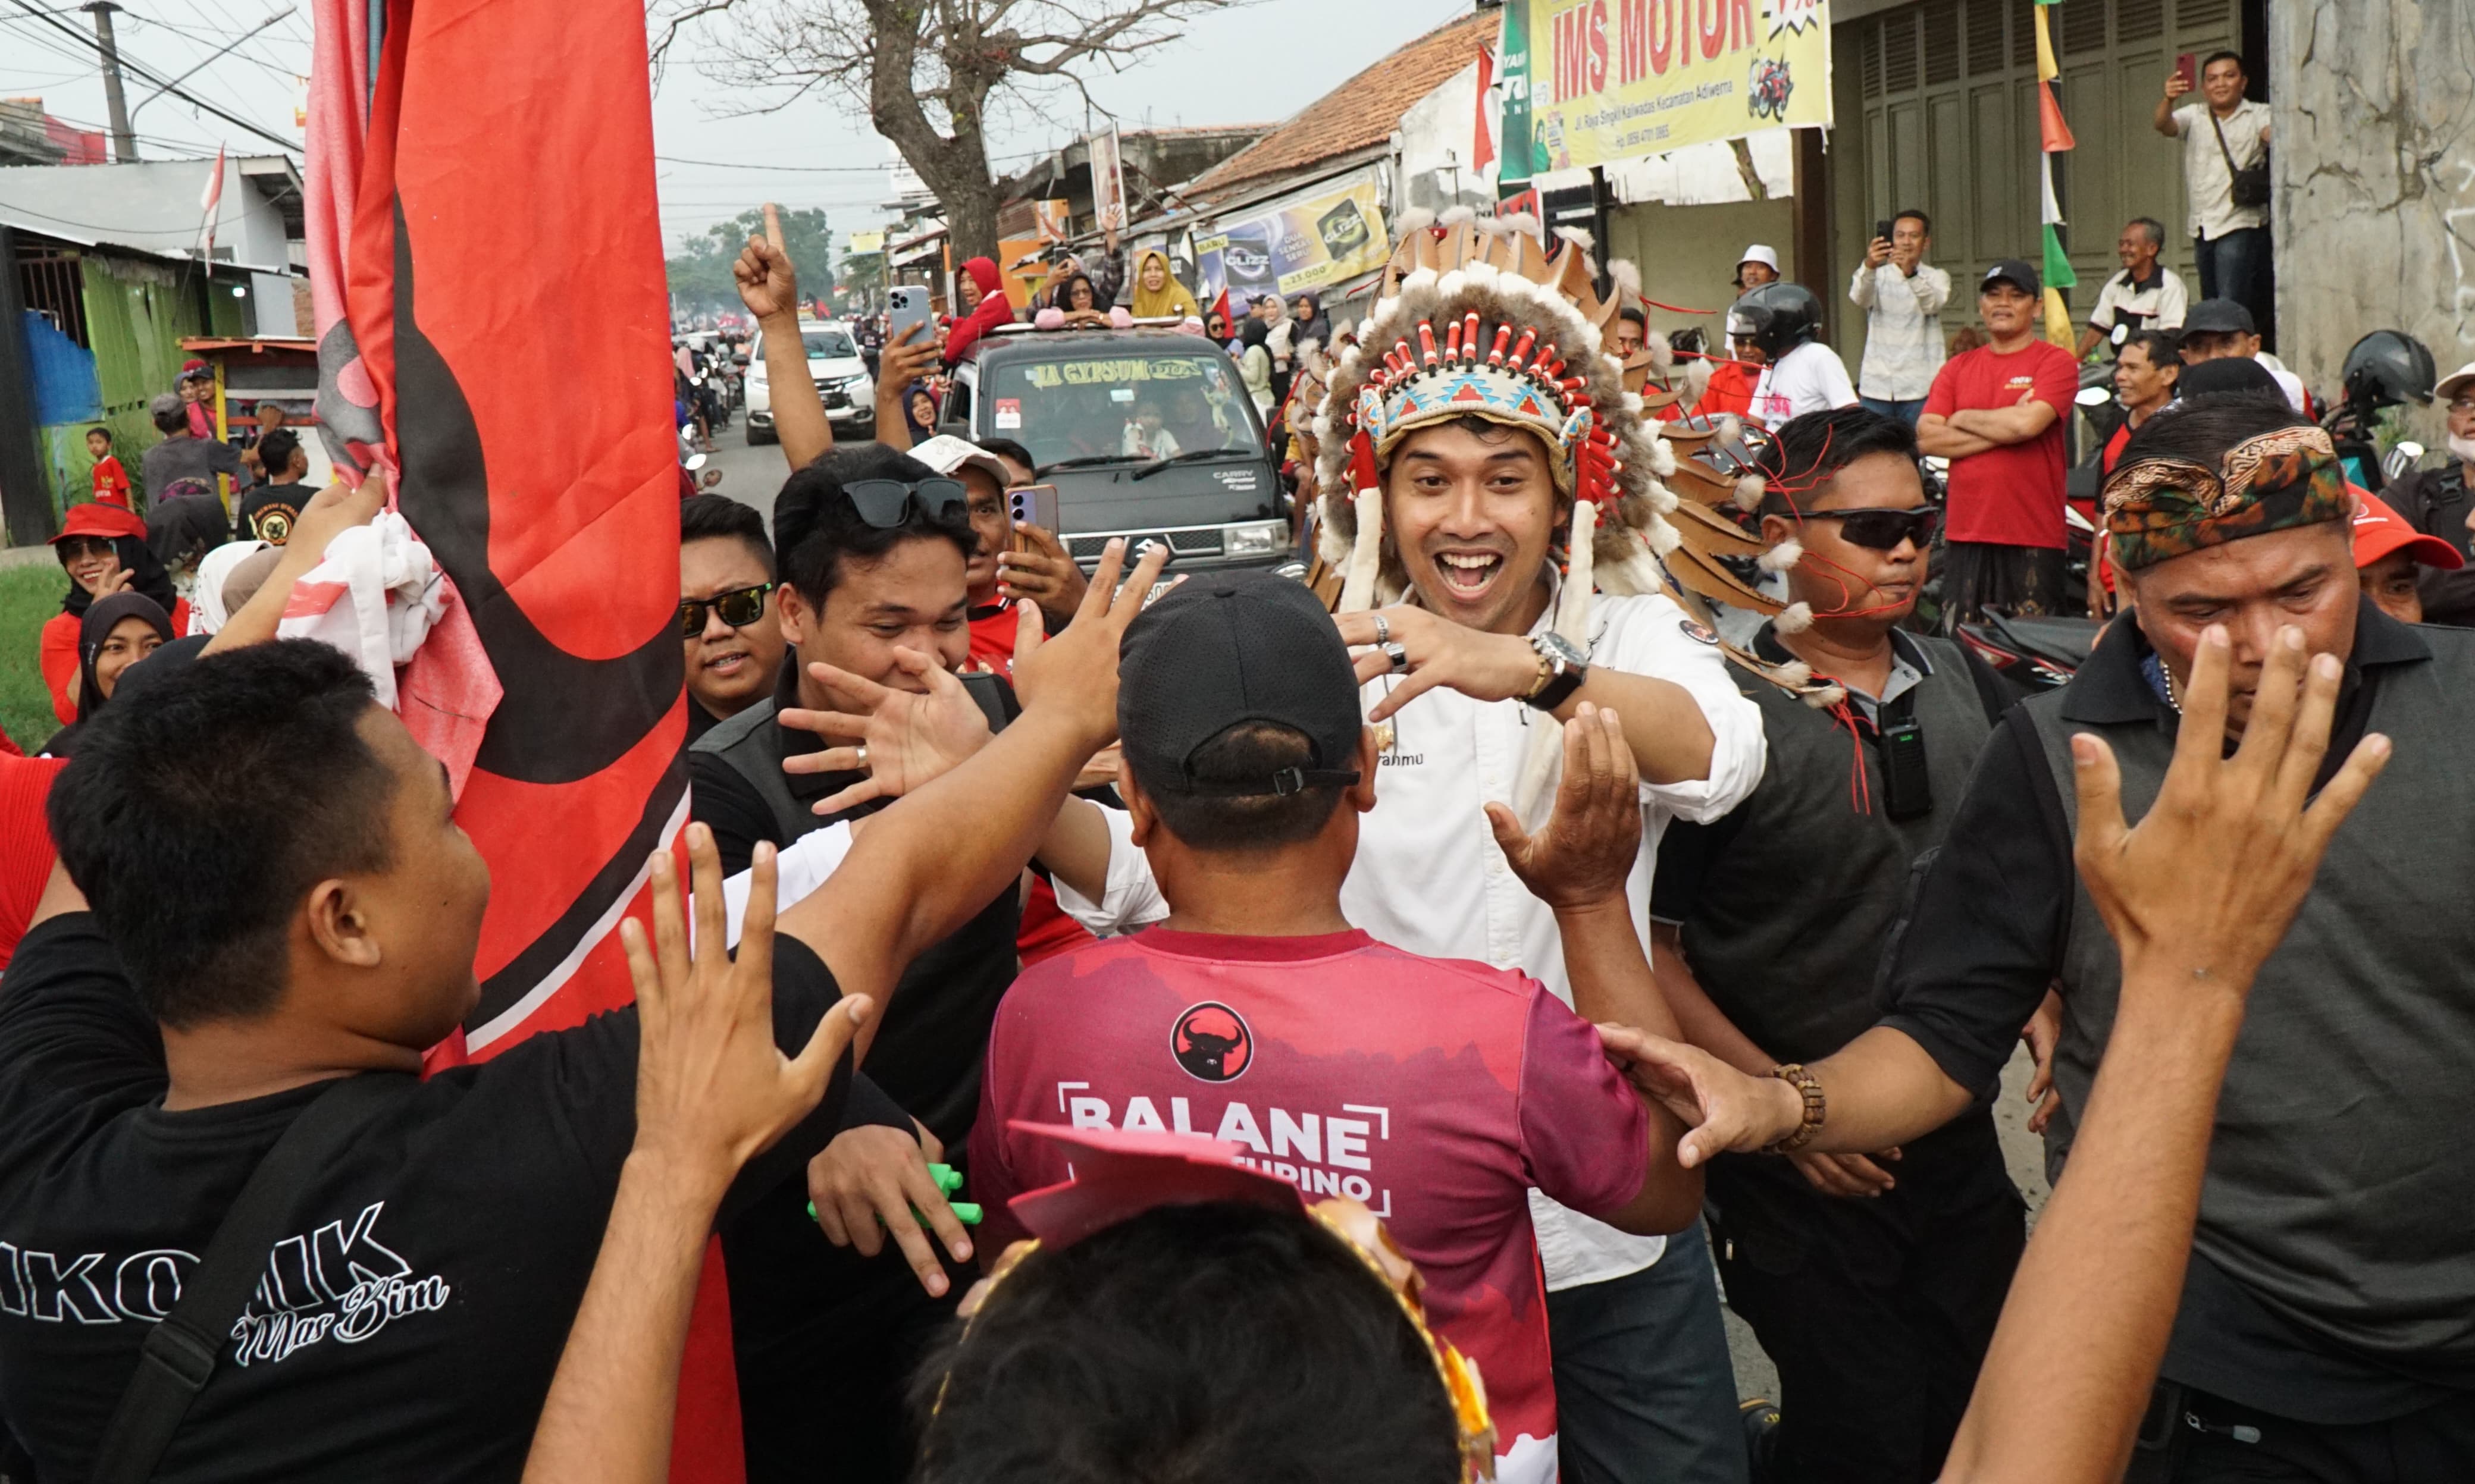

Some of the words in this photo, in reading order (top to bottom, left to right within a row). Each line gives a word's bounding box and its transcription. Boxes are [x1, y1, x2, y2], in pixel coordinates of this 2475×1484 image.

[1553, 0, 1608, 103] IMS
[1620, 0, 1755, 85] MOTOR
[1656, 90, 1694, 110] Kecamatan
[1696, 80, 1733, 101] Adiwerna
[1198, 238, 1224, 252] BARU
[1279, 237, 1314, 256] SENSASI
[1284, 232, 1303, 245] DUA
[1063, 359, 1151, 385] GYPSUM
[1213, 469, 1254, 479] CARRY
[1070, 1096, 1371, 1171] BALANE
[230, 1310, 335, 1367] Mas
